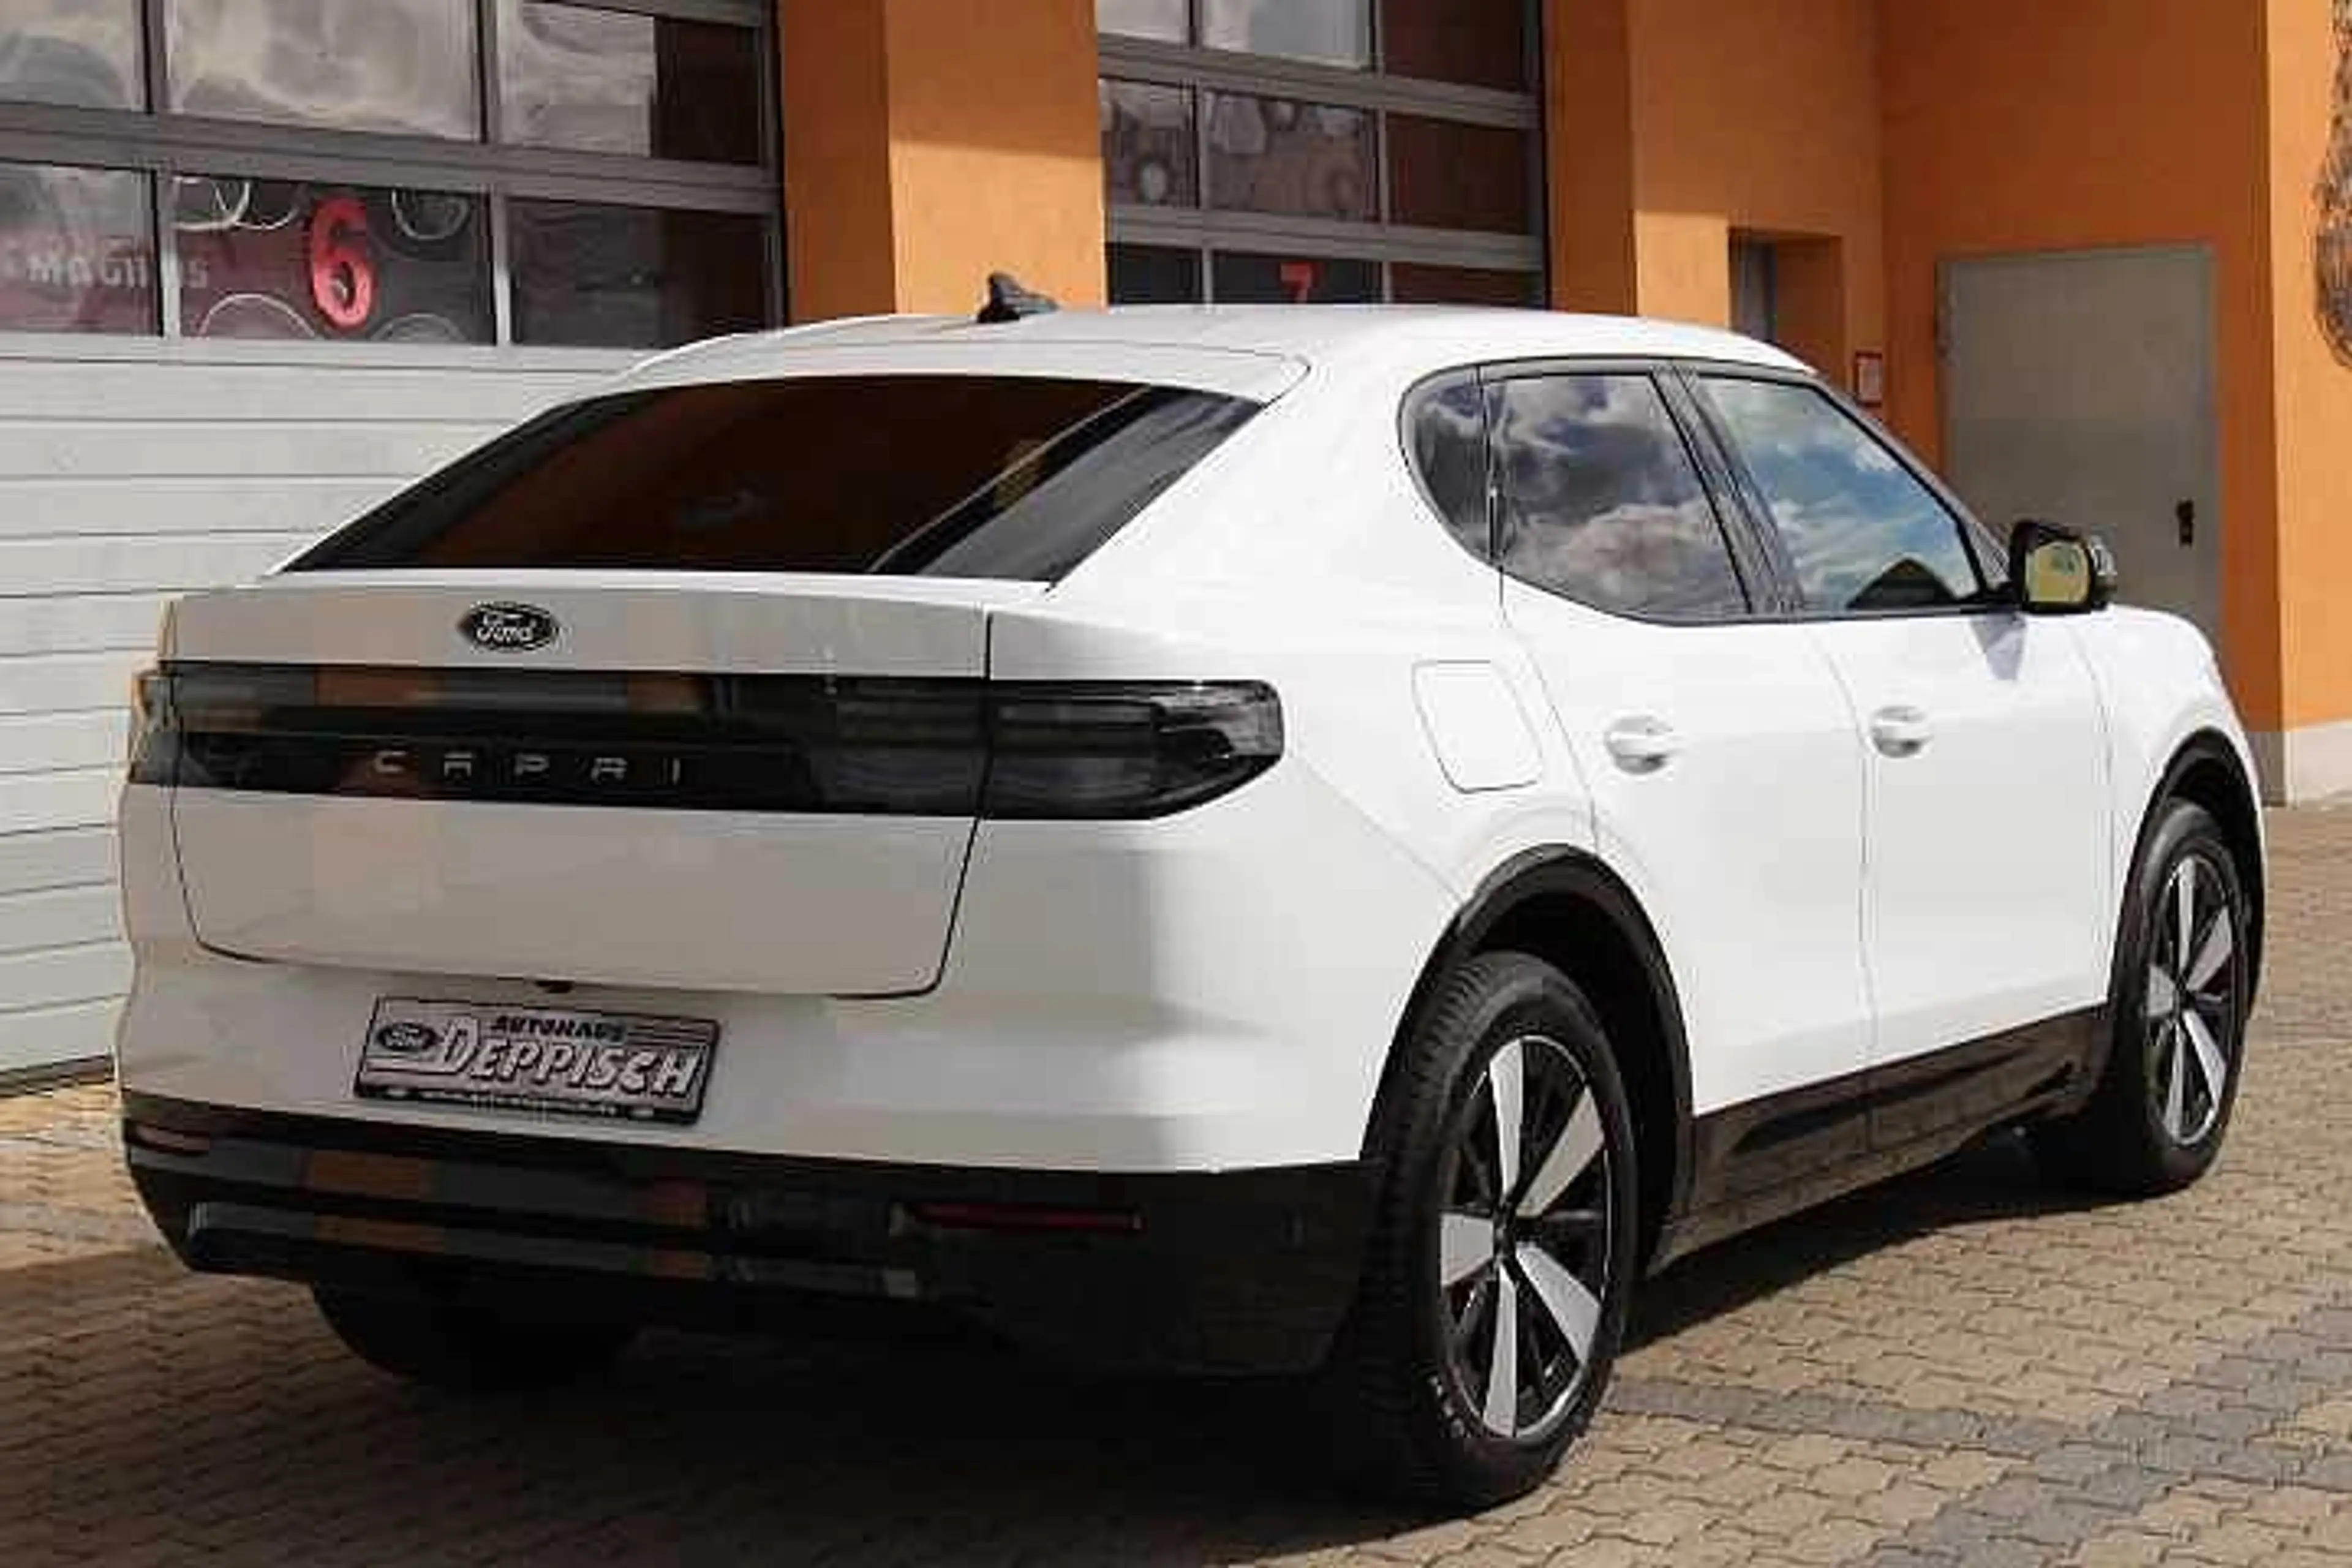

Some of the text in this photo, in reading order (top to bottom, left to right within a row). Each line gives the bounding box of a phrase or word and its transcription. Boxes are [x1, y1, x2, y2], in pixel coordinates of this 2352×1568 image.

[310, 197, 375, 329] 6
[1280, 262, 1313, 303] 7
[476, 612, 537, 642] Ford
[374, 749, 681, 784] CAPRI
[441, 1018, 703, 1096] DEPPISCH
